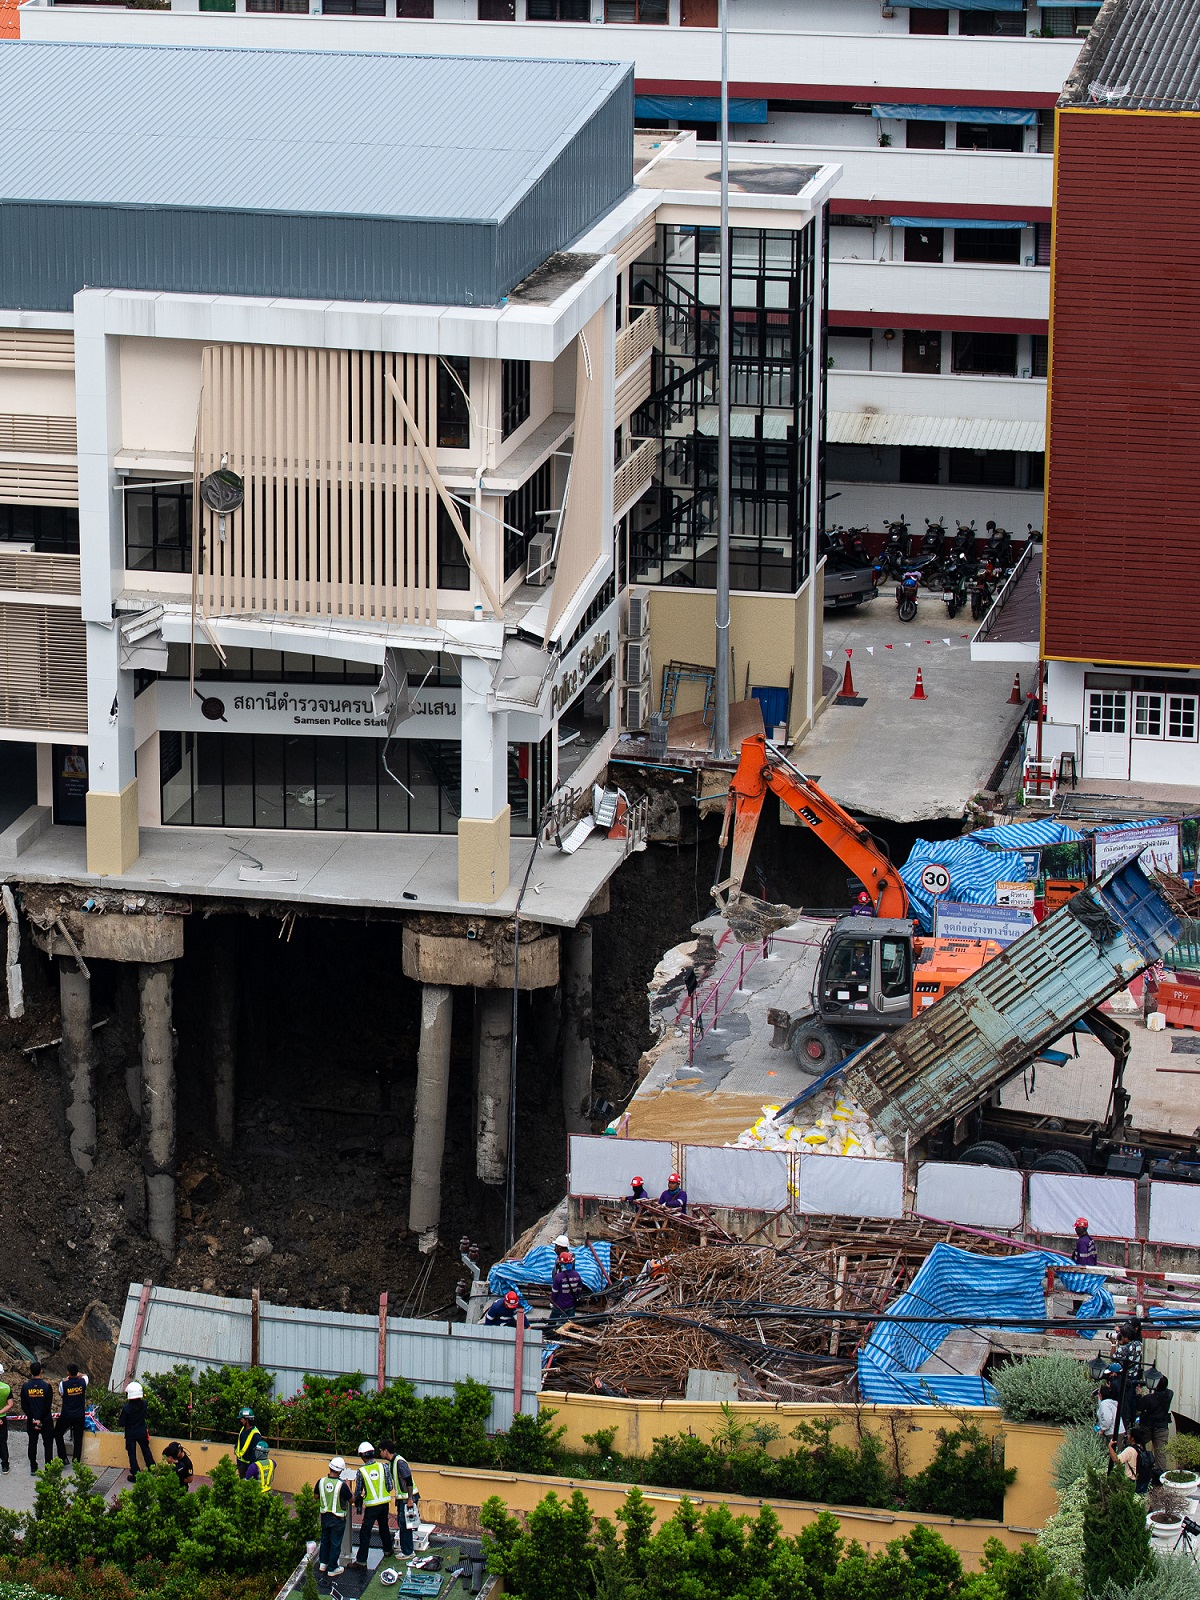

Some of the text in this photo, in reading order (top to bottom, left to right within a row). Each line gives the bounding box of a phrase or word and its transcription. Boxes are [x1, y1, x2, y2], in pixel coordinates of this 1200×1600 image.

[293, 716, 388, 728] Samsen Police Stati
[924, 871, 947, 886] 30
